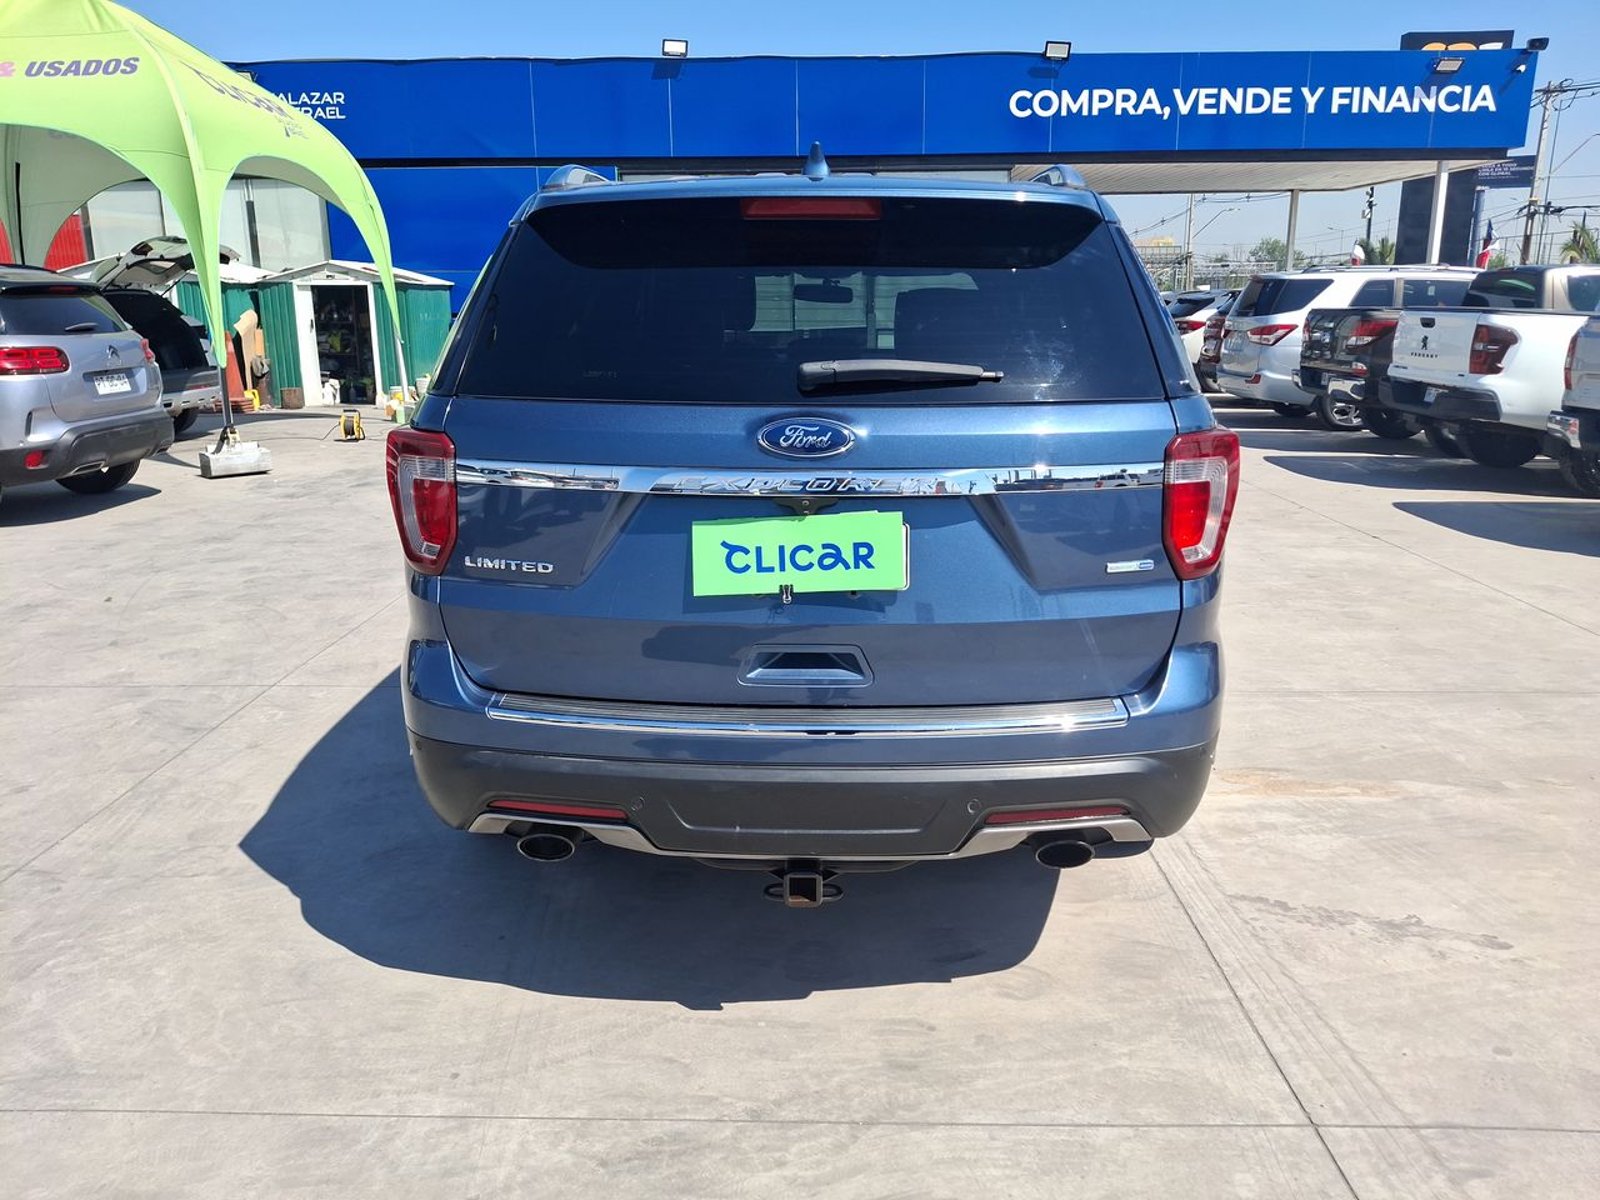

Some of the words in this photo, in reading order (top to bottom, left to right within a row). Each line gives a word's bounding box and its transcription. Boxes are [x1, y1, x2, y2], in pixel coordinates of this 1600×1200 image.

[24, 57, 140, 77] USADOS
[272, 92, 345, 105] ALAZAR
[1009, 88, 1171, 120] COMPRA,
[1172, 86, 1294, 115] VENDE
[1300, 86, 1325, 114] Y
[1331, 84, 1497, 114] FINANCIA
[779, 424, 832, 448] Ford
[464, 555, 554, 574] LIMITED
